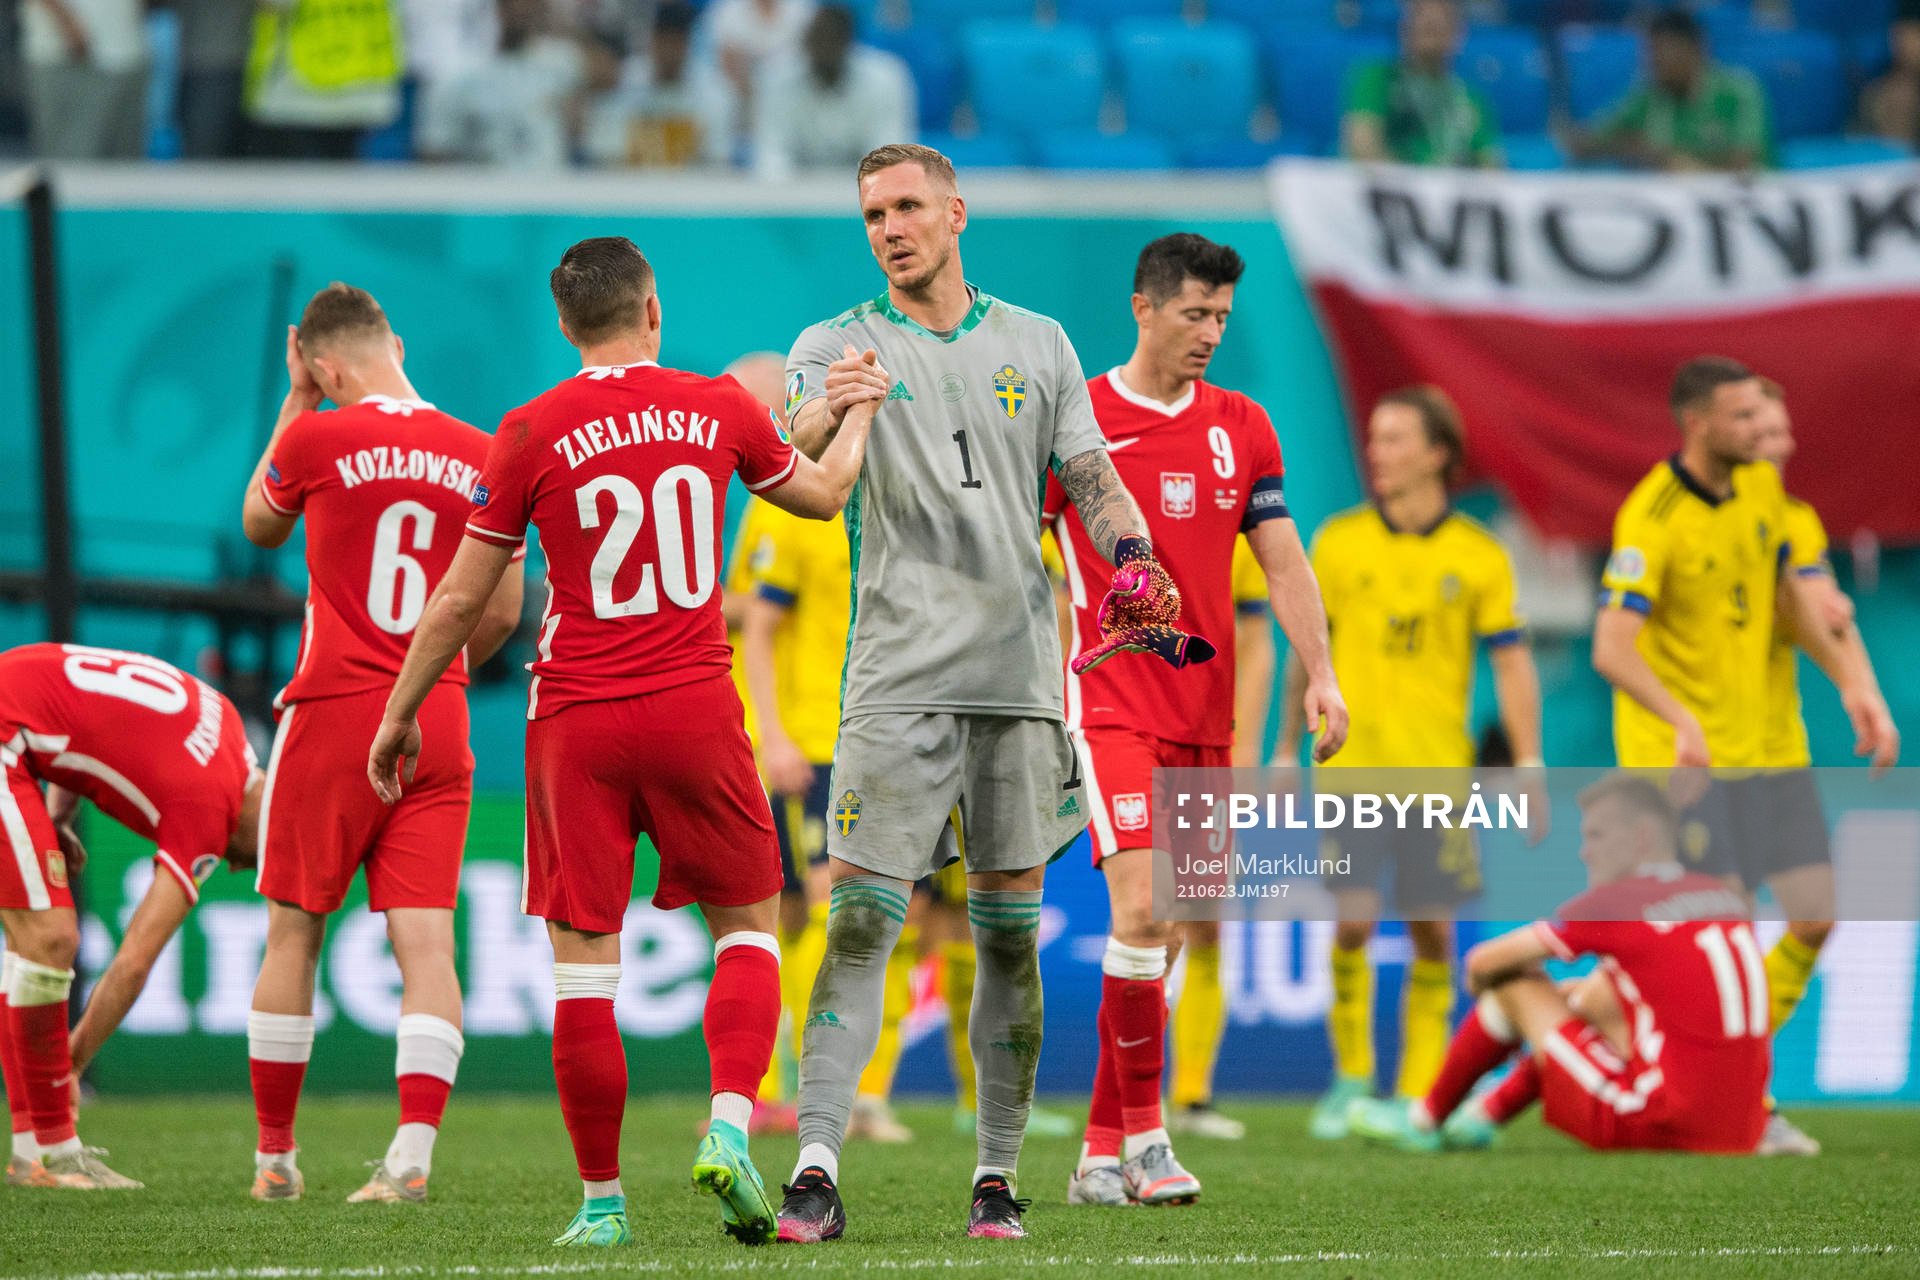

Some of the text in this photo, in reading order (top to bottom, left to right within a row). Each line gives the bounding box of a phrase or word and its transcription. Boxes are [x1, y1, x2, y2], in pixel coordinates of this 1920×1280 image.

[553, 404, 720, 470] ZIELIŃSKI
[952, 429, 982, 489] 1
[1207, 425, 1236, 479] 9
[335, 446, 481, 503] KOZŁOWSK
[366, 500, 437, 636] 6
[574, 464, 716, 620] 20
[1694, 922, 1769, 1038] 11
